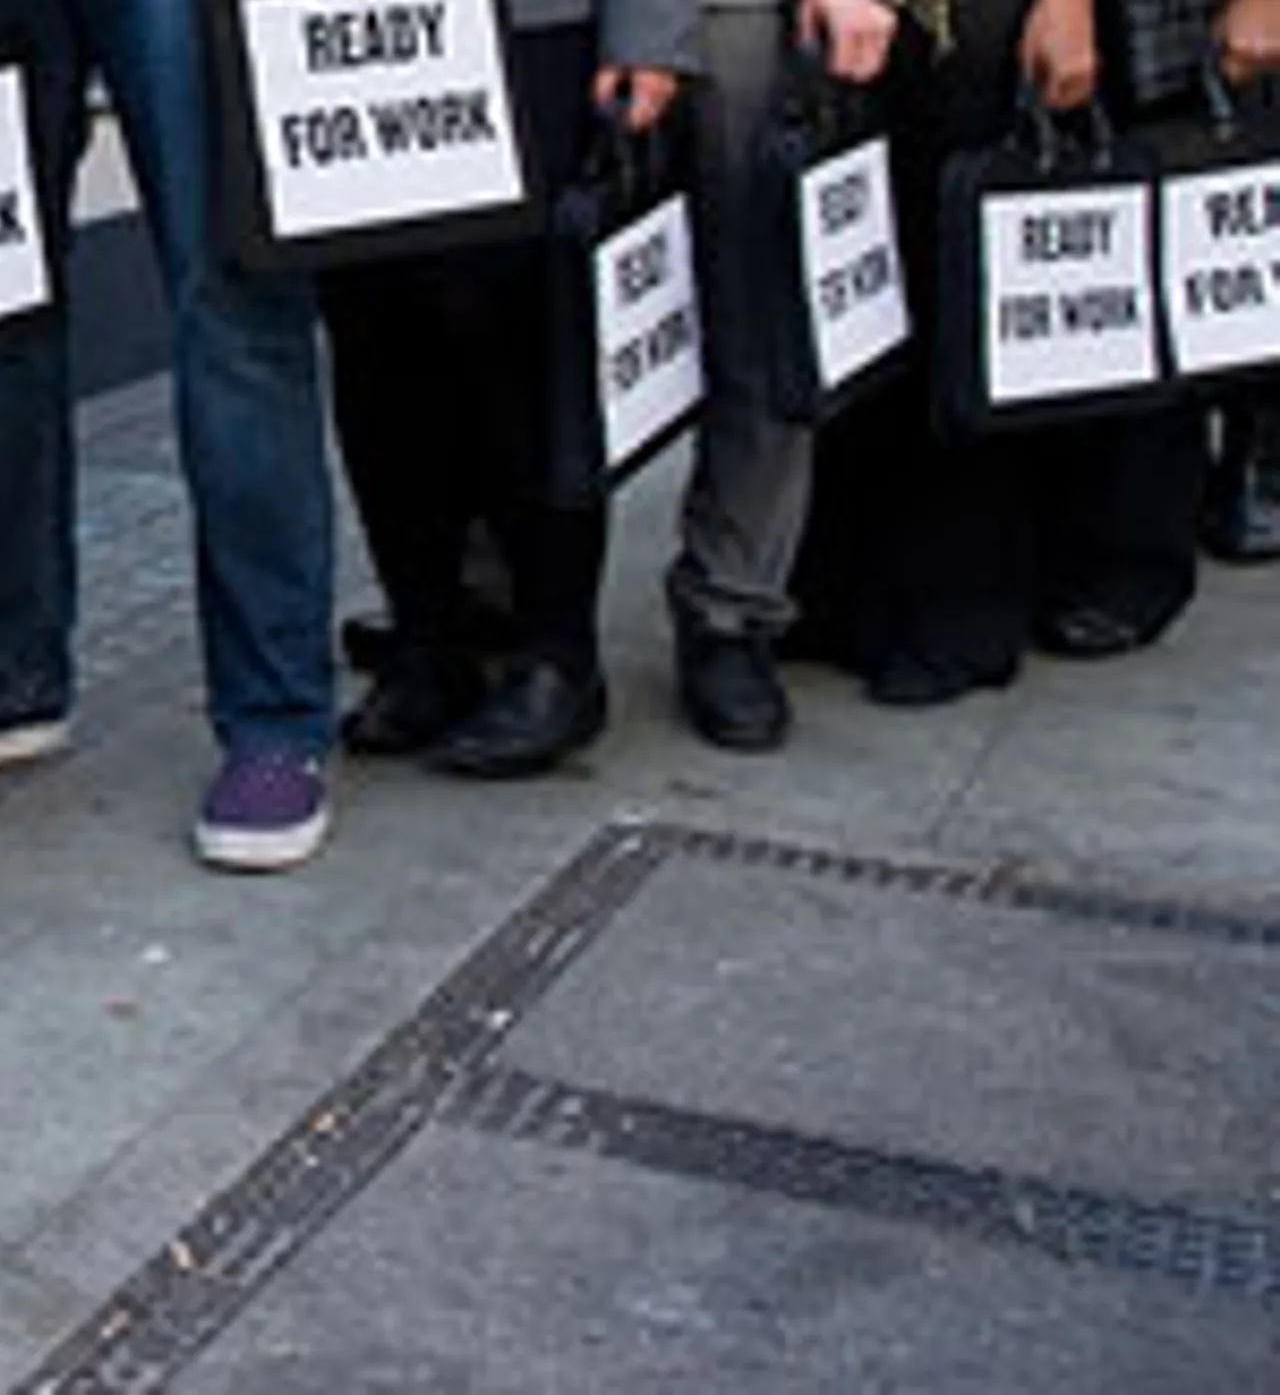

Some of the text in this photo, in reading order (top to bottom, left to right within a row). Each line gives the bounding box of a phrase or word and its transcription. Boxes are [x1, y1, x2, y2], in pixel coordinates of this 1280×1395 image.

[304, 0, 445, 73] READY
[281, 90, 496, 169] FOR WORK
